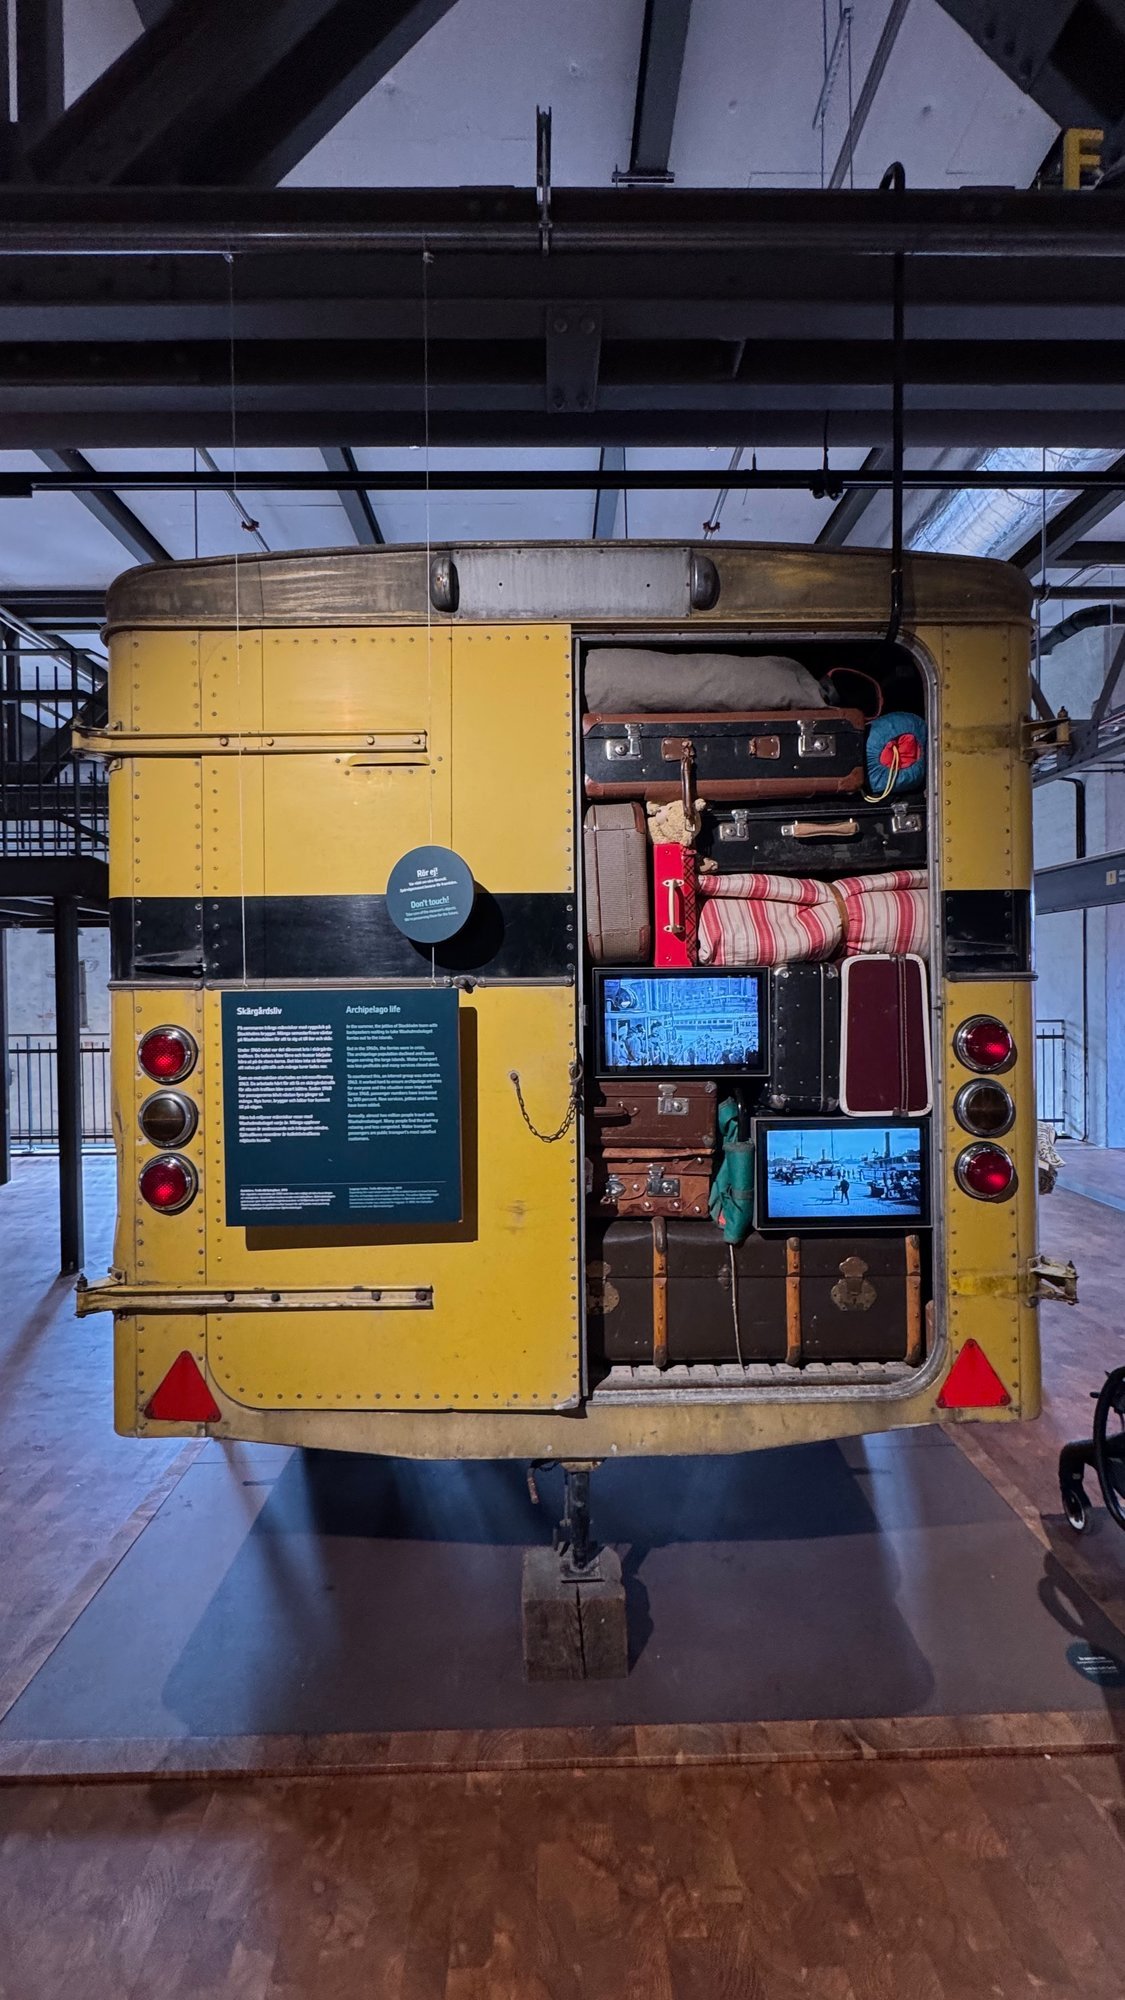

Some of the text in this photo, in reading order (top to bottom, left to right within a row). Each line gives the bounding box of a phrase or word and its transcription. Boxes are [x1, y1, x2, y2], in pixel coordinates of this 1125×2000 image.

[1063, 128, 1104, 190] F
[416, 867, 438, 878] Rör ej!
[410, 896, 449, 908] Don't touch!
[236, 1006, 282, 1016] Skärgårdsliv
[346, 1006, 388, 1015] Archipelago
